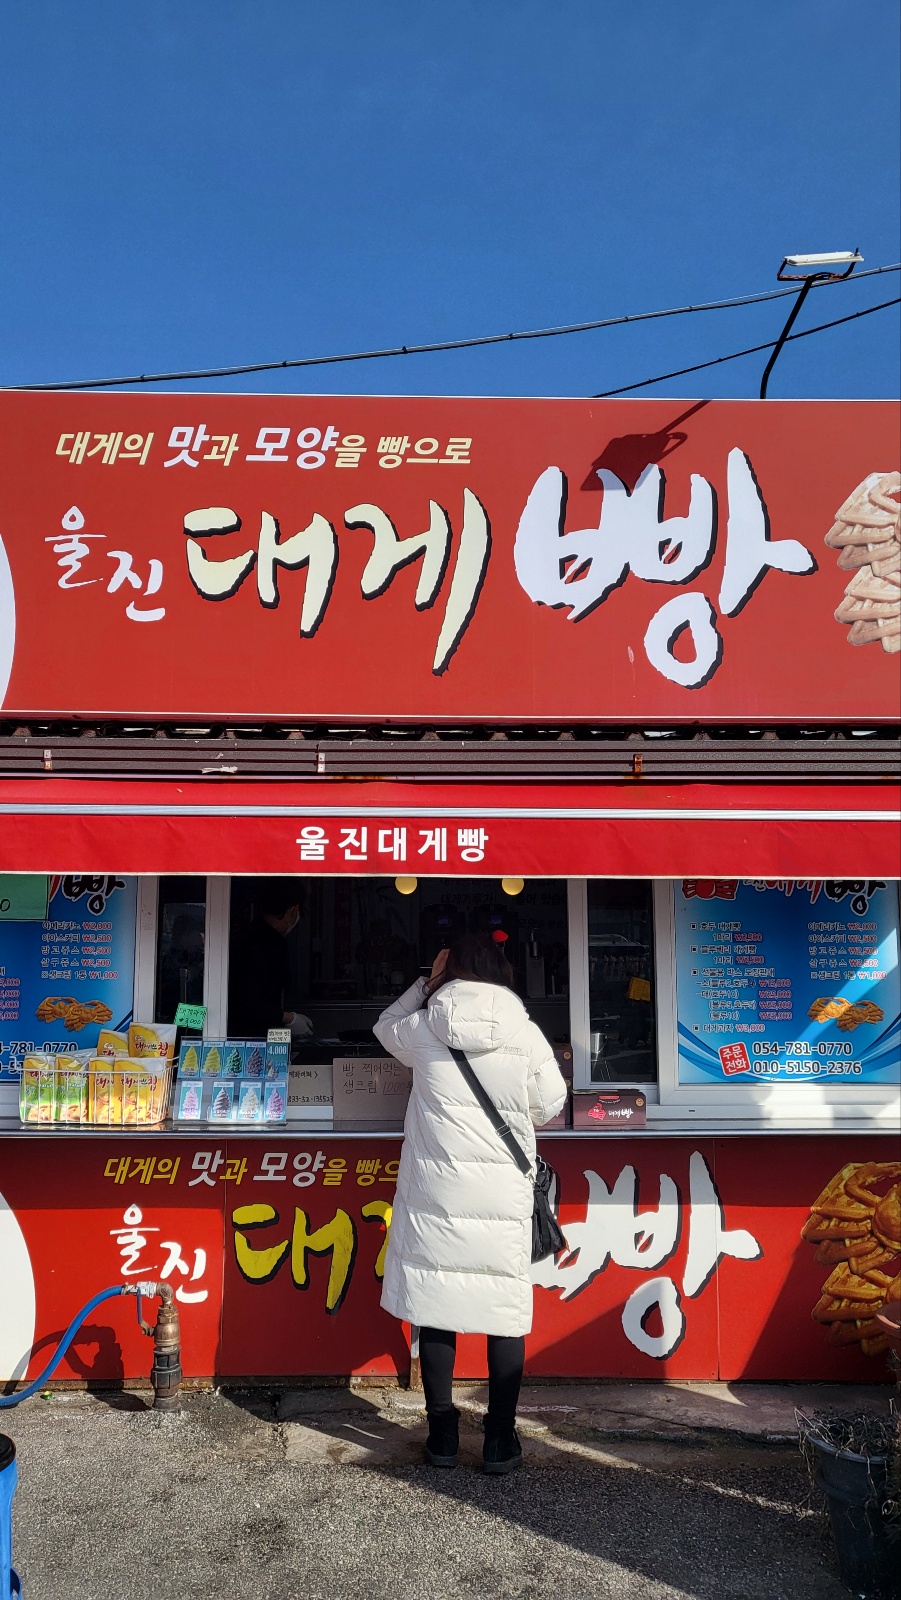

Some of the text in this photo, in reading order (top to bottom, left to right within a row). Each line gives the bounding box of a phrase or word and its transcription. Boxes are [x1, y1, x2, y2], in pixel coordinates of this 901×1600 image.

[55, 423, 473, 470] 대게의 맛과 모양을 빵으로
[44, 505, 166, 623] 울진
[296, 826, 489, 862] 울진대게빵
[267, 1045, 287, 1055] 4,000
[722, 1044, 743, 1060] 주문
[753, 1042, 853, 1056] 054-781-0770
[342, 1062, 355, 1077] 빵
[726, 1058, 748, 1073] 전화
[753, 1061, 862, 1076] 010-5150-2376
[343, 1080, 378, 1095] 생크림
[103, 1150, 400, 1188] 대게의 맛과 모양을 빵으
[109, 1203, 209, 1304] 울진
